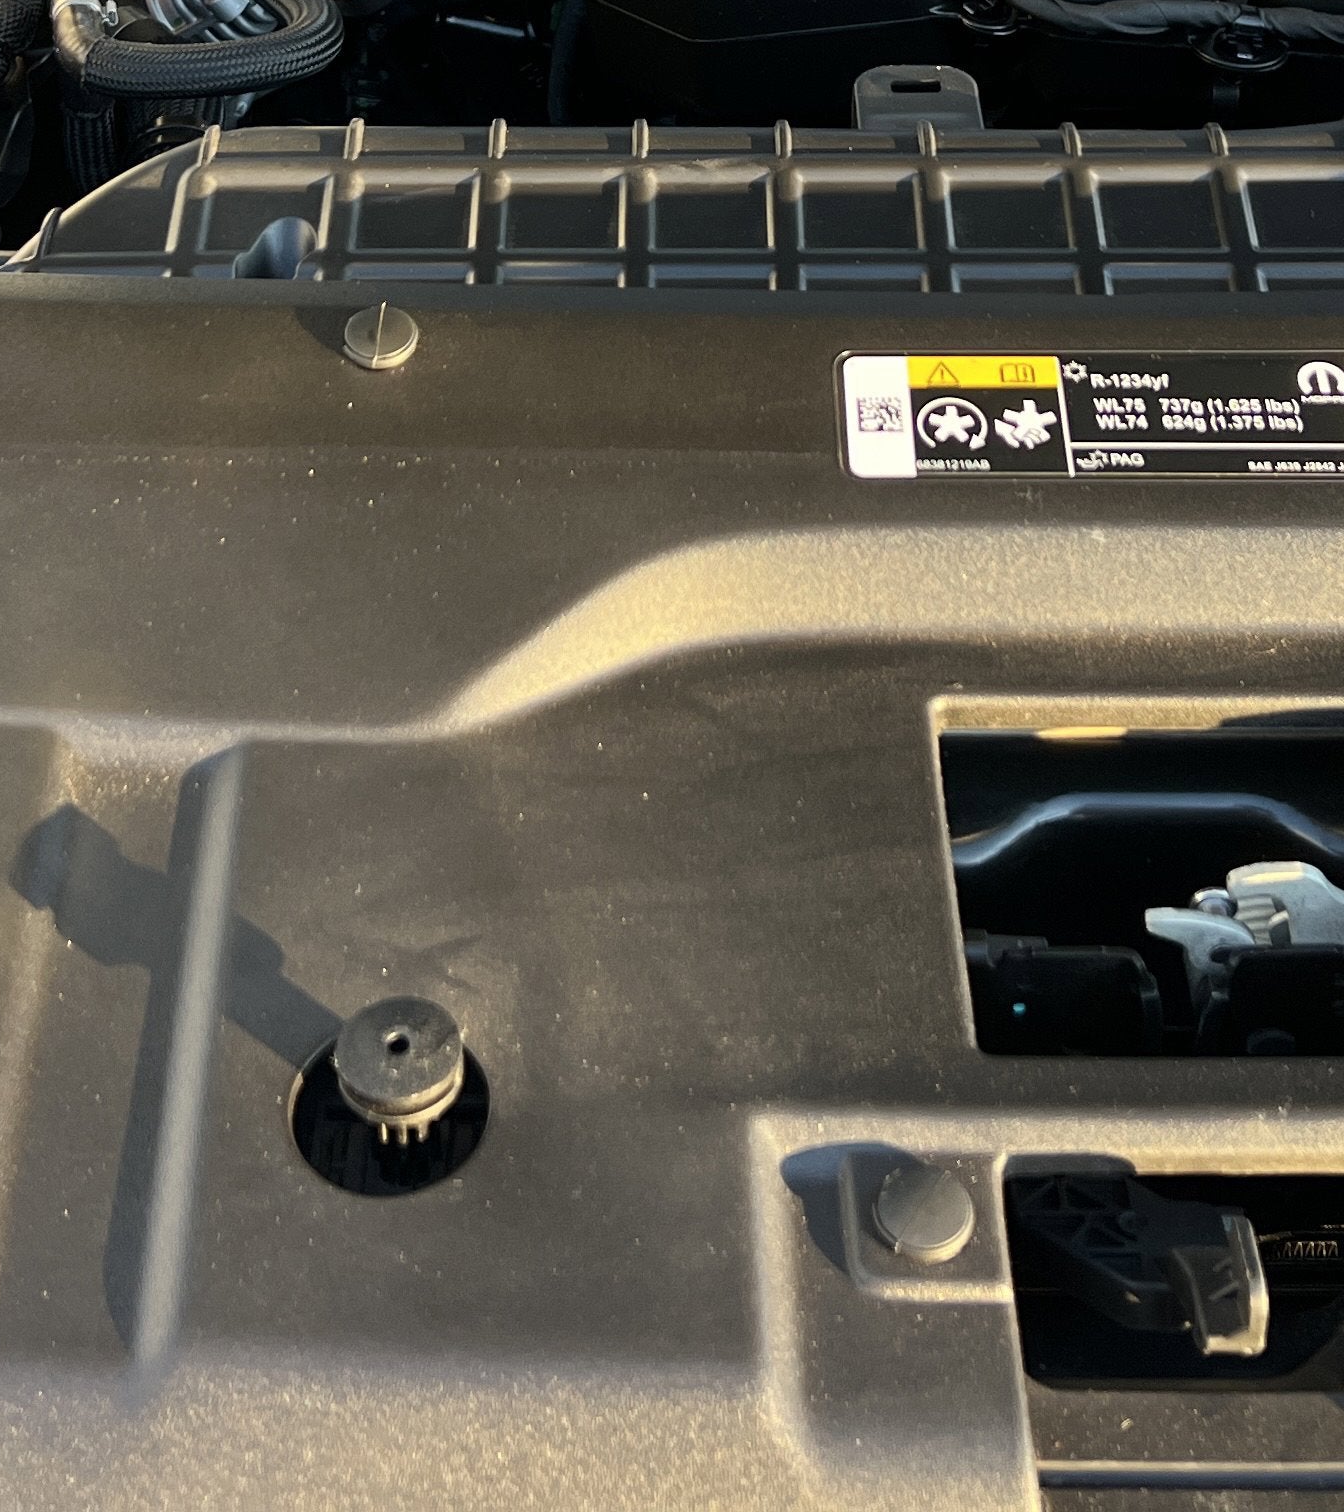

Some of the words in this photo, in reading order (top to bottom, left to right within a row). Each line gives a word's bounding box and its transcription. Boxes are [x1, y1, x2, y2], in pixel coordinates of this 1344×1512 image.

[1090, 373, 1170, 392] R-1234yf
[1093, 397, 1146, 414] WL75
[1159, 397, 1204, 415] 737g
[1207, 397, 1262, 415] (1.625
[1265, 397, 1301, 415] lbs)
[1095, 414, 1149, 431] WL74
[1161, 415, 1207, 434] 624g
[1210, 414, 1266, 432] (1.375
[1268, 414, 1304, 434] lbs)
[1110, 452, 1146, 467] PAG
